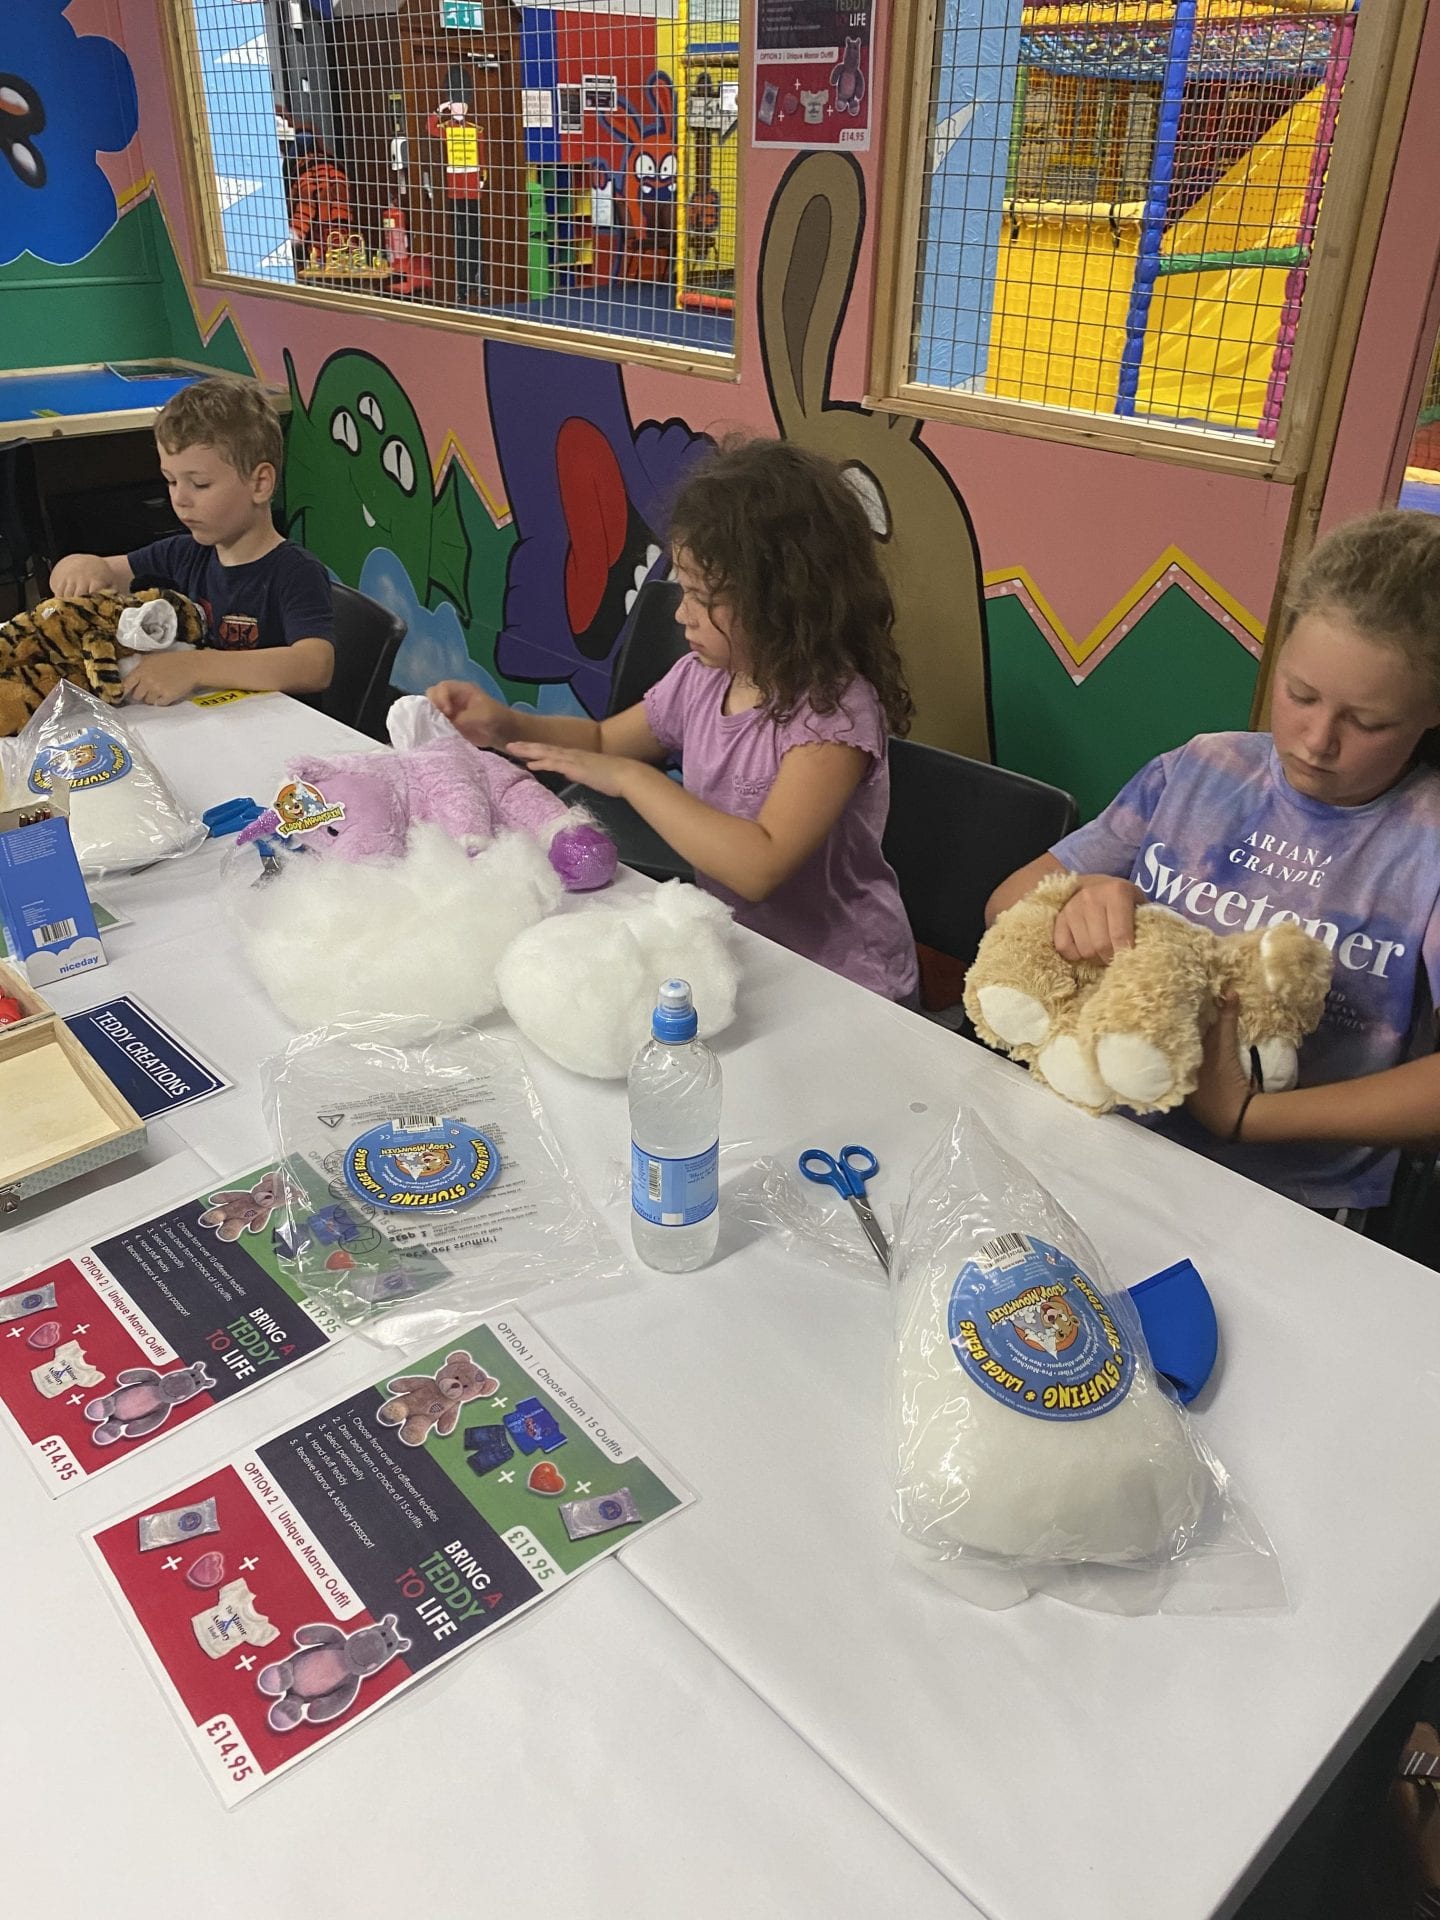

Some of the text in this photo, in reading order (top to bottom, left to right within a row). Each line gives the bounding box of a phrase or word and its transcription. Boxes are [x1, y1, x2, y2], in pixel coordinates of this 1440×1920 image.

[849, 13, 867, 27] LIFE
[841, 131, 865, 142] £14.95
[201, 693, 238, 707] KEEP
[68, 771, 110, 788] STUFFI
[278, 807, 343, 835] TEDDY MOUNTAIN
[1229, 847, 1325, 888] GRANDE
[1243, 831, 1333, 869] ARIANA
[1134, 842, 1405, 979] Sweetener
[60, 955, 99, 974] niceday
[95, 1011, 192, 1096] TEDDY CREATIONS
[380, 1142, 455, 1155] TEDDY MOUNTAIN
[353, 1148, 383, 1193] LARGE BEARS
[388, 1184, 467, 1206] STUFFING
[79, 1255, 105, 1280] OPTION
[104, 1289, 133, 1315] Unique
[125, 1313, 151, 1337] Manor
[144, 1335, 168, 1357] Outfit
[986, 1289, 1041, 1325] MOUNTAIN
[1040, 1281, 1068, 1301] TEDDY
[247, 1306, 297, 1355] BRING A
[302, 1298, 342, 1334] £19.95
[202, 1327, 256, 1380] TO LIFE
[224, 1315, 280, 1368] TEDDY
[959, 1320, 990, 1362] BEARS
[979, 1359, 1026, 1394] LARGE
[1012, 1356, 1053, 1377] Pre-Mulched
[1043, 1360, 1123, 1410] STUFFING
[493, 1321, 530, 1354] OPTION
[534, 1366, 569, 1398] Choose
[563, 1395, 588, 1417] from
[583, 1415, 598, 1428] 15
[593, 1427, 626, 1457] Outfits
[337, 1423, 354, 1440] Dress
[349, 1437, 365, 1454] bear
[38, 1438, 79, 1481] £14.95
[309, 1438, 326, 1456] Hand
[320, 1453, 336, 1468] stuff
[329, 1466, 349, 1487] teddy
[323, 1430, 342, 1450] Select
[335, 1447, 366, 1482] personality
[351, 1416, 373, 1440] Choose
[368, 1437, 385, 1454] from
[379, 1451, 394, 1466] over
[390, 1464, 402, 1474] 10
[396, 1471, 421, 1498] different
[416, 1496, 440, 1522] teddies
[360, 1451, 376, 1467] from
[294, 1445, 317, 1471] Receive
[311, 1469, 332, 1491] Manor
[329, 1494, 355, 1522] Ashbury
[348, 1519, 375, 1550] passport
[375, 1470, 397, 1494] choice
[398, 1500, 409, 1509] 15
[403, 1507, 424, 1529] outfits
[242, 1461, 351, 1609] OPTION 2 Unique Manor Outfit
[506, 1529, 556, 1581] £19.95
[416, 1549, 486, 1626] TEDDY
[443, 1538, 506, 1609] BRING A
[391, 1566, 458, 1641] TO LIFE
[205, 1718, 254, 1784] £14.95
